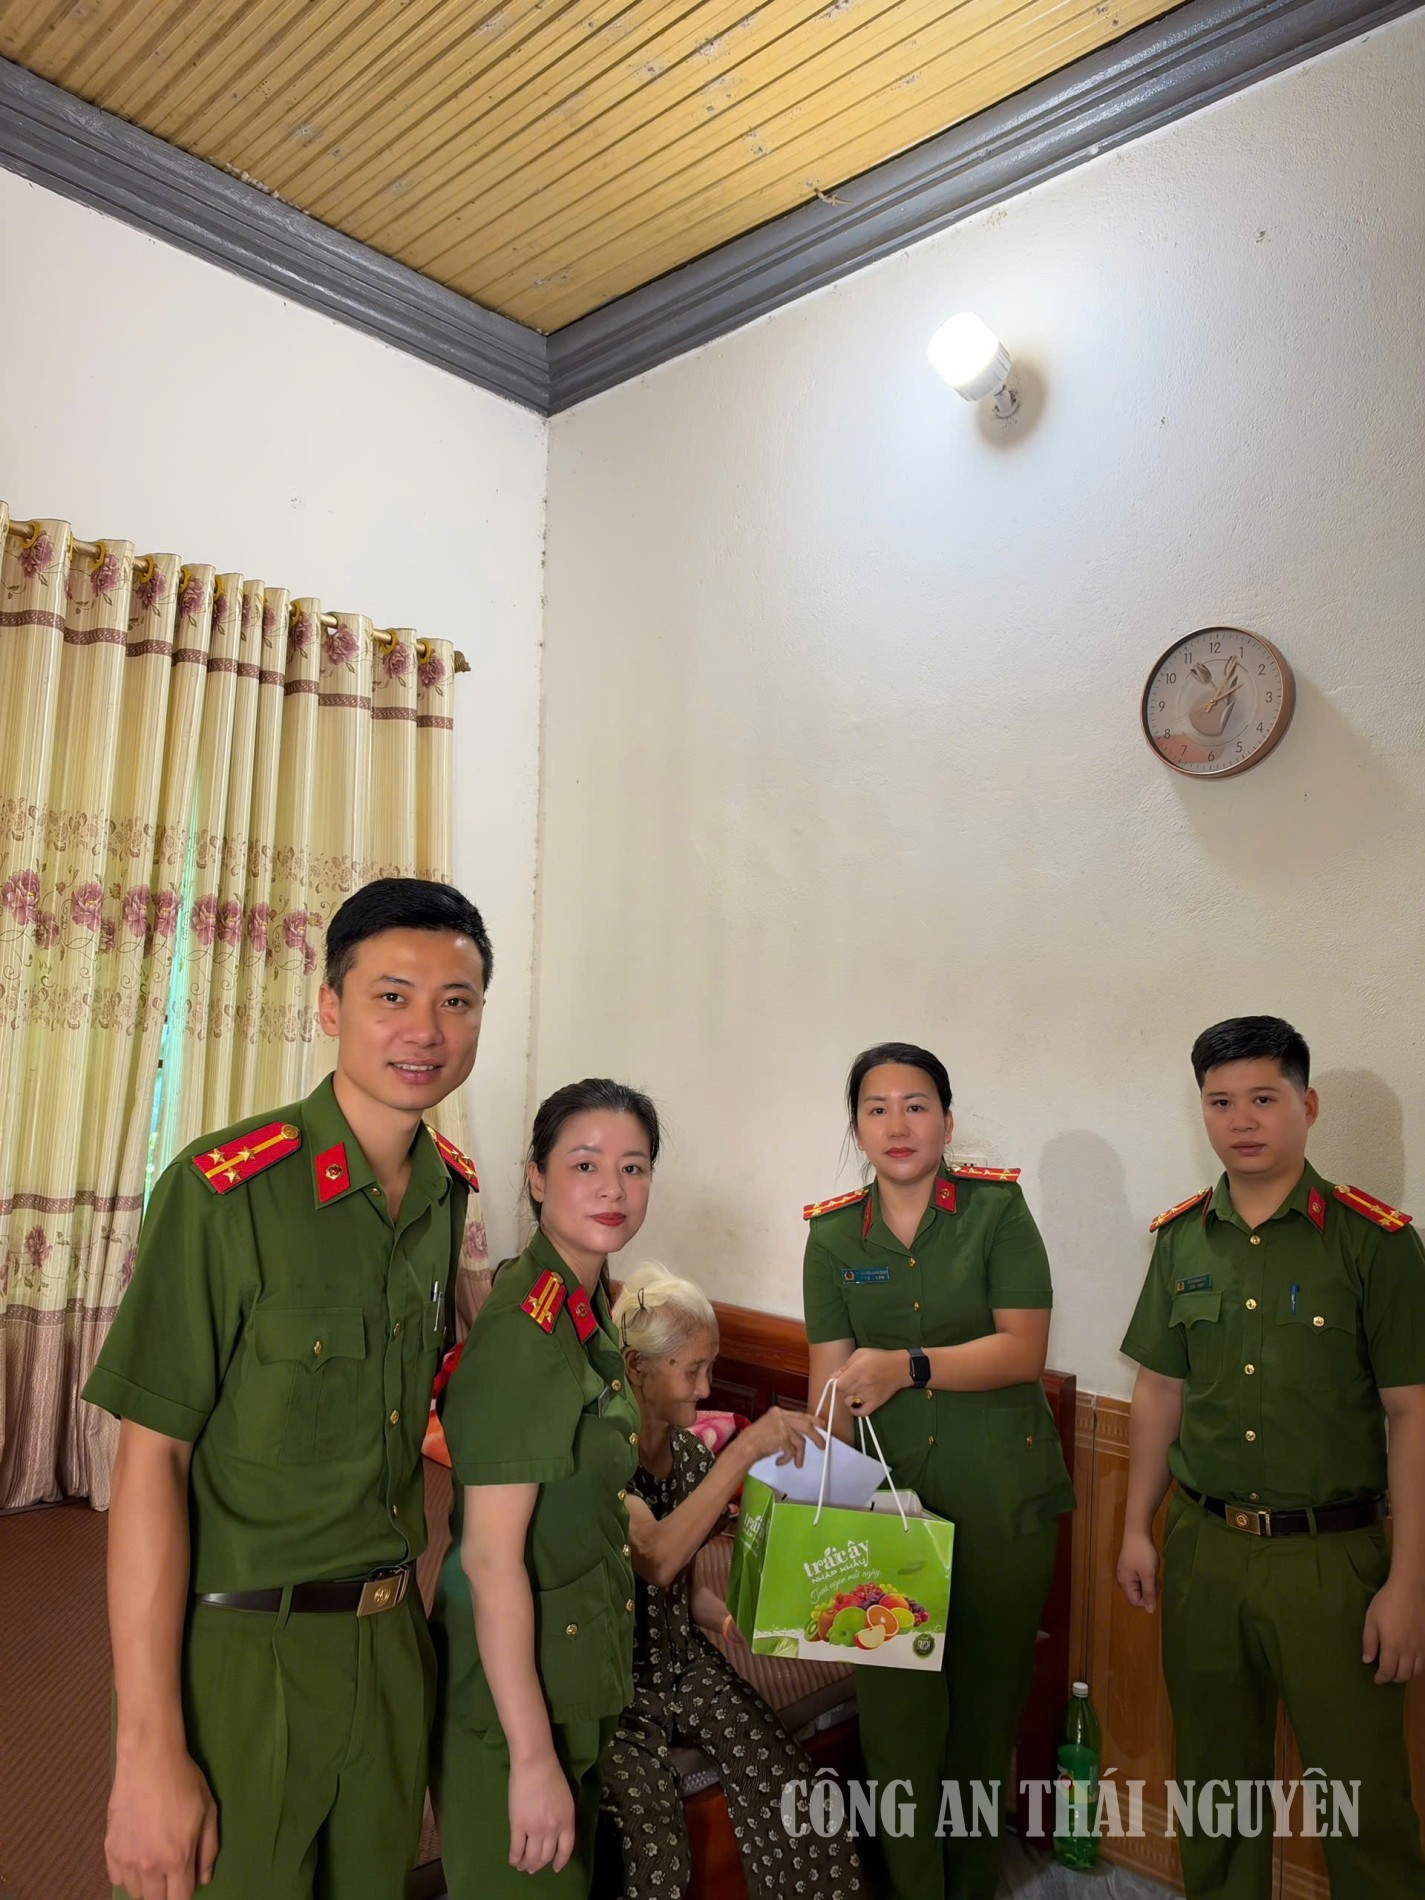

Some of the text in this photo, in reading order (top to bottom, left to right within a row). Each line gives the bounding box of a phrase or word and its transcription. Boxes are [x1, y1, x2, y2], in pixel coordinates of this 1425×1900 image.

[1209, 642, 1221, 654] 12
[1184, 653, 1193, 664] 11
[1258, 664, 1266, 675] 2
[1165, 673, 1177, 684] 10
[1265, 691, 1273, 703] 3
[1158, 701, 1166, 711] 9
[1256, 722, 1264, 733] 4
[1164, 729, 1171, 739] 8
[1180, 745, 1188, 756] 7
[1236, 741, 1243, 752] 5
[1207, 751, 1215, 761] 6
